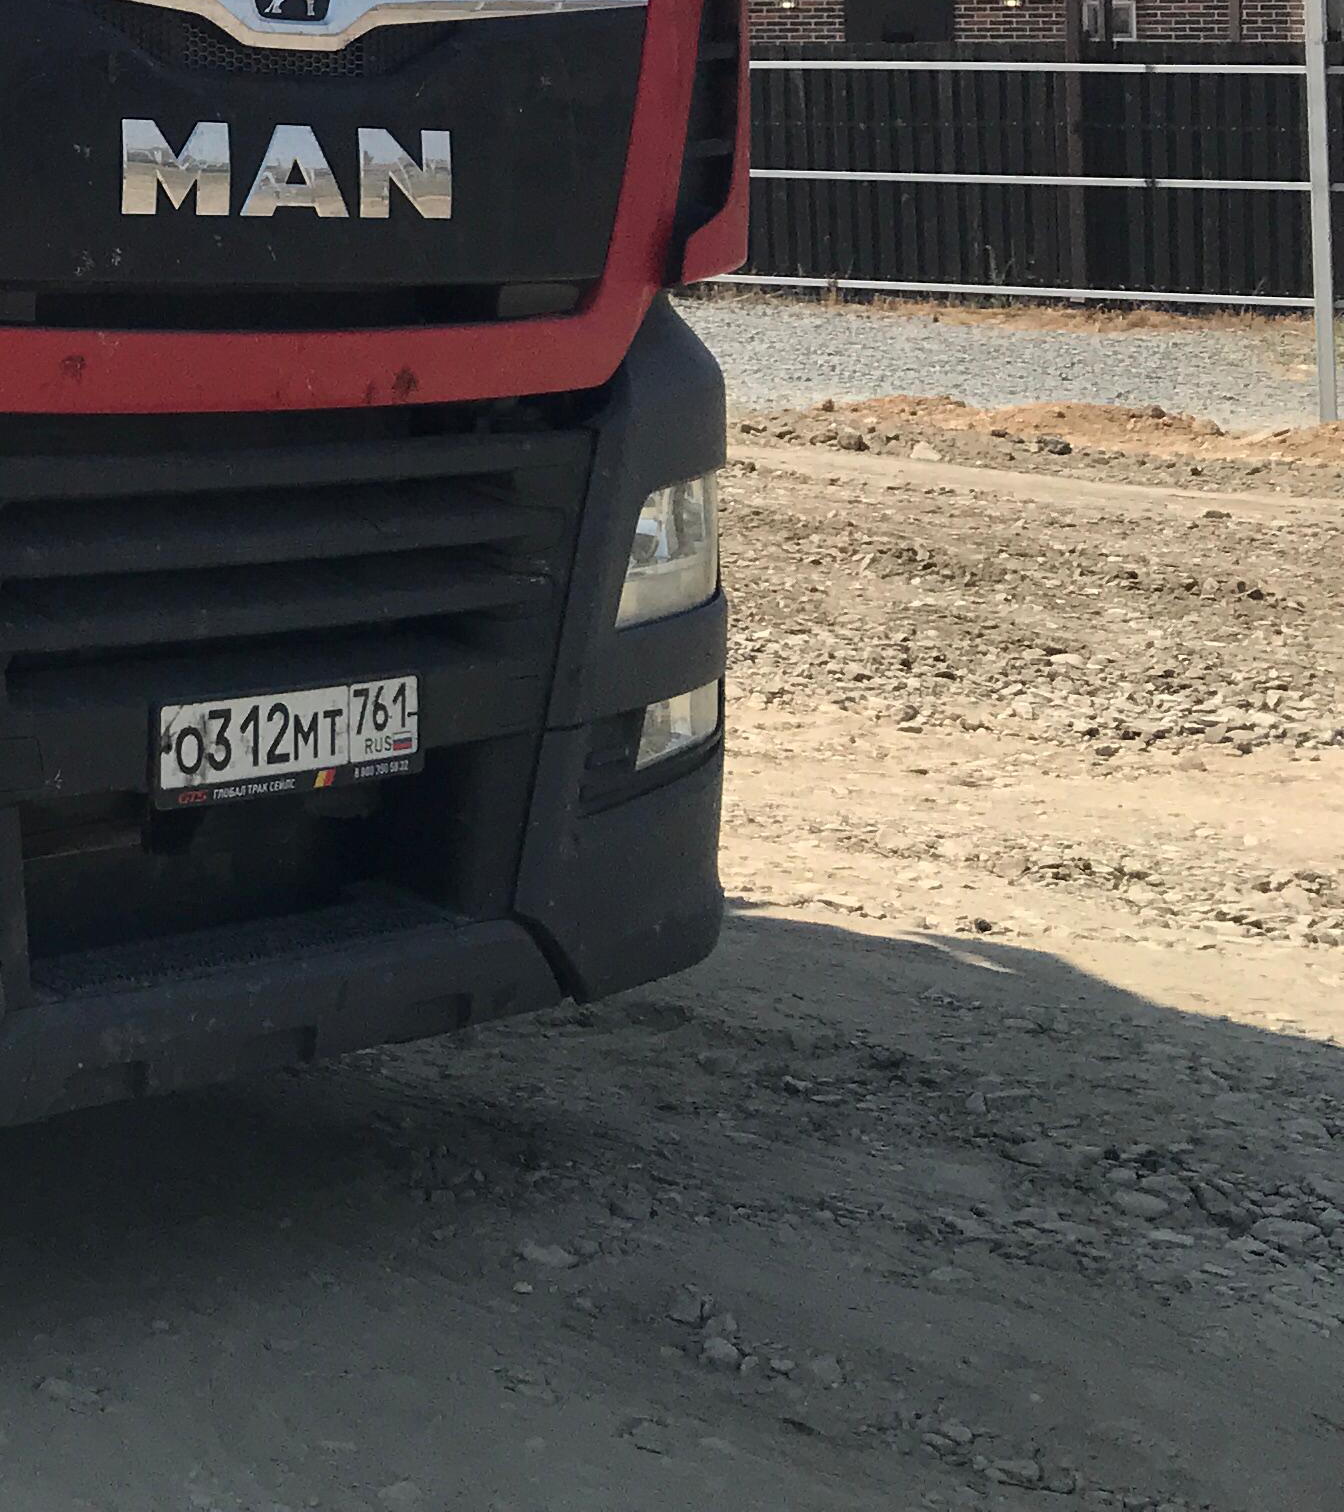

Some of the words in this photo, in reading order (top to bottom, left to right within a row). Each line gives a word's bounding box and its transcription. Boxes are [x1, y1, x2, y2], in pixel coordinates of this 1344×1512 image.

[120, 117, 453, 220] MAN
[353, 682, 407, 736] 761
[364, 737, 393, 755] RUS
